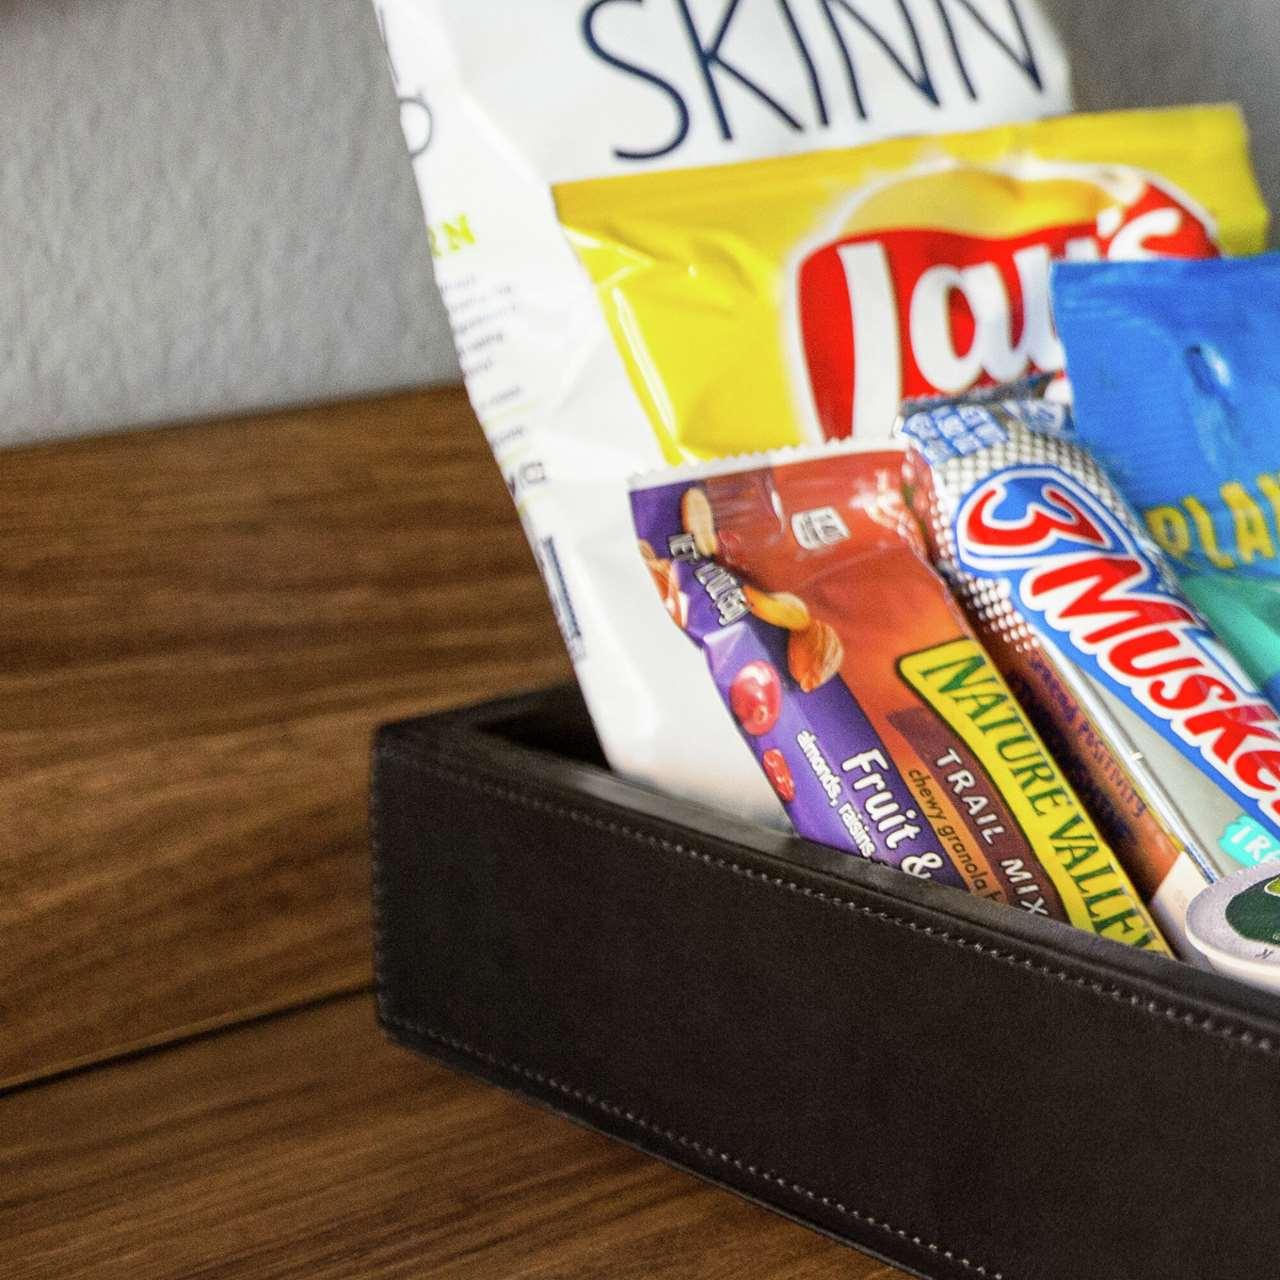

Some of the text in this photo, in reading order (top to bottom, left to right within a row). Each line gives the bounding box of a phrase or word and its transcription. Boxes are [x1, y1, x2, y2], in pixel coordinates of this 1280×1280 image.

[966, 484, 1106, 548] 3
[796, 730, 842, 807] almonds,
[841, 748, 943, 880] Fruit &
[908, 768, 989, 893] chewy granola
[920, 654, 1153, 949] NATURE VALLE
[936, 747, 1049, 915] TRAIL MIX
